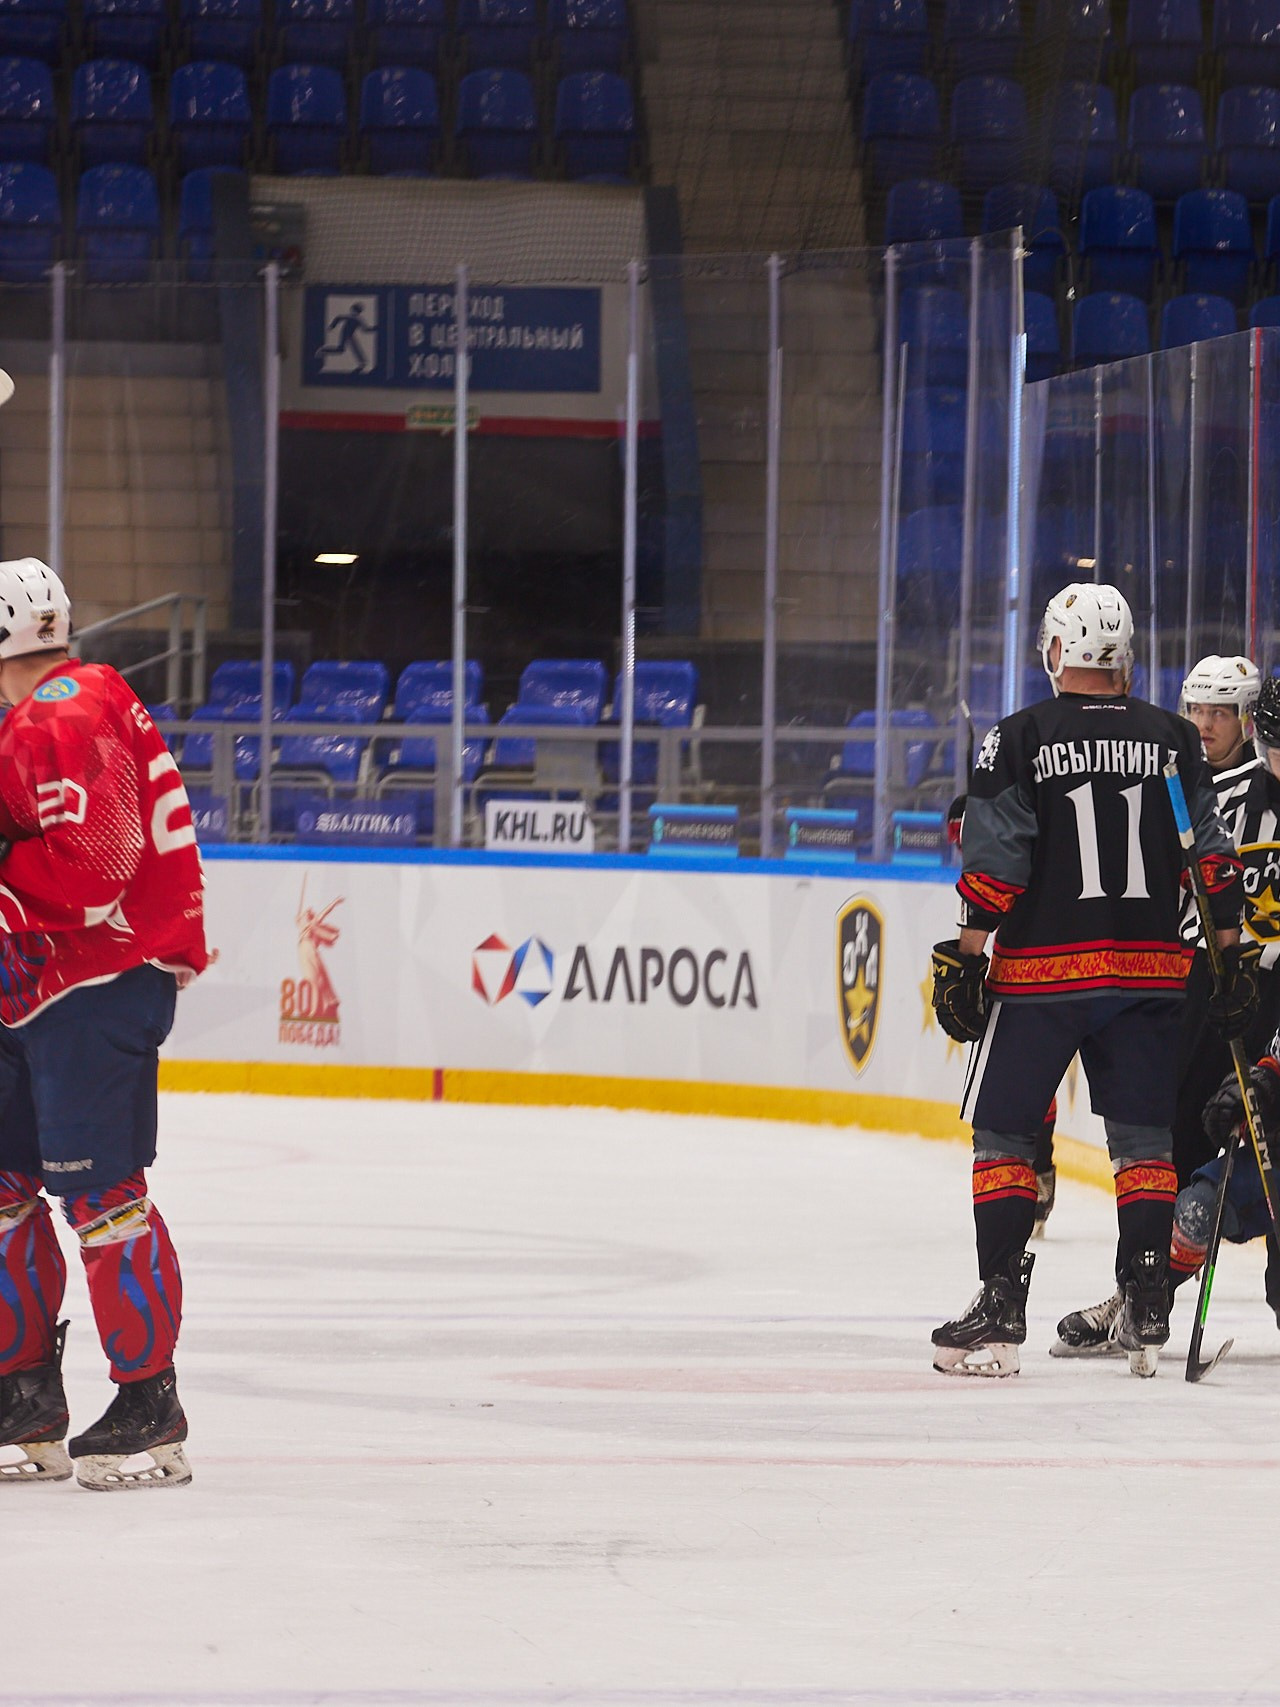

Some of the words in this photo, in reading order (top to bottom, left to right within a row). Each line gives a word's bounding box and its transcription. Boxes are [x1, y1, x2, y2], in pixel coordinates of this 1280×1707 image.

[408, 323, 425, 347] В
[494, 810, 589, 844] KHL.RU
[1065, 780, 1151, 900] 11
[564, 944, 758, 1008] АЛРОСА
[279, 977, 319, 1019] 80
[278, 1023, 341, 1048] ПОБЕДА!
[1245, 1086, 1273, 1171] CCM
